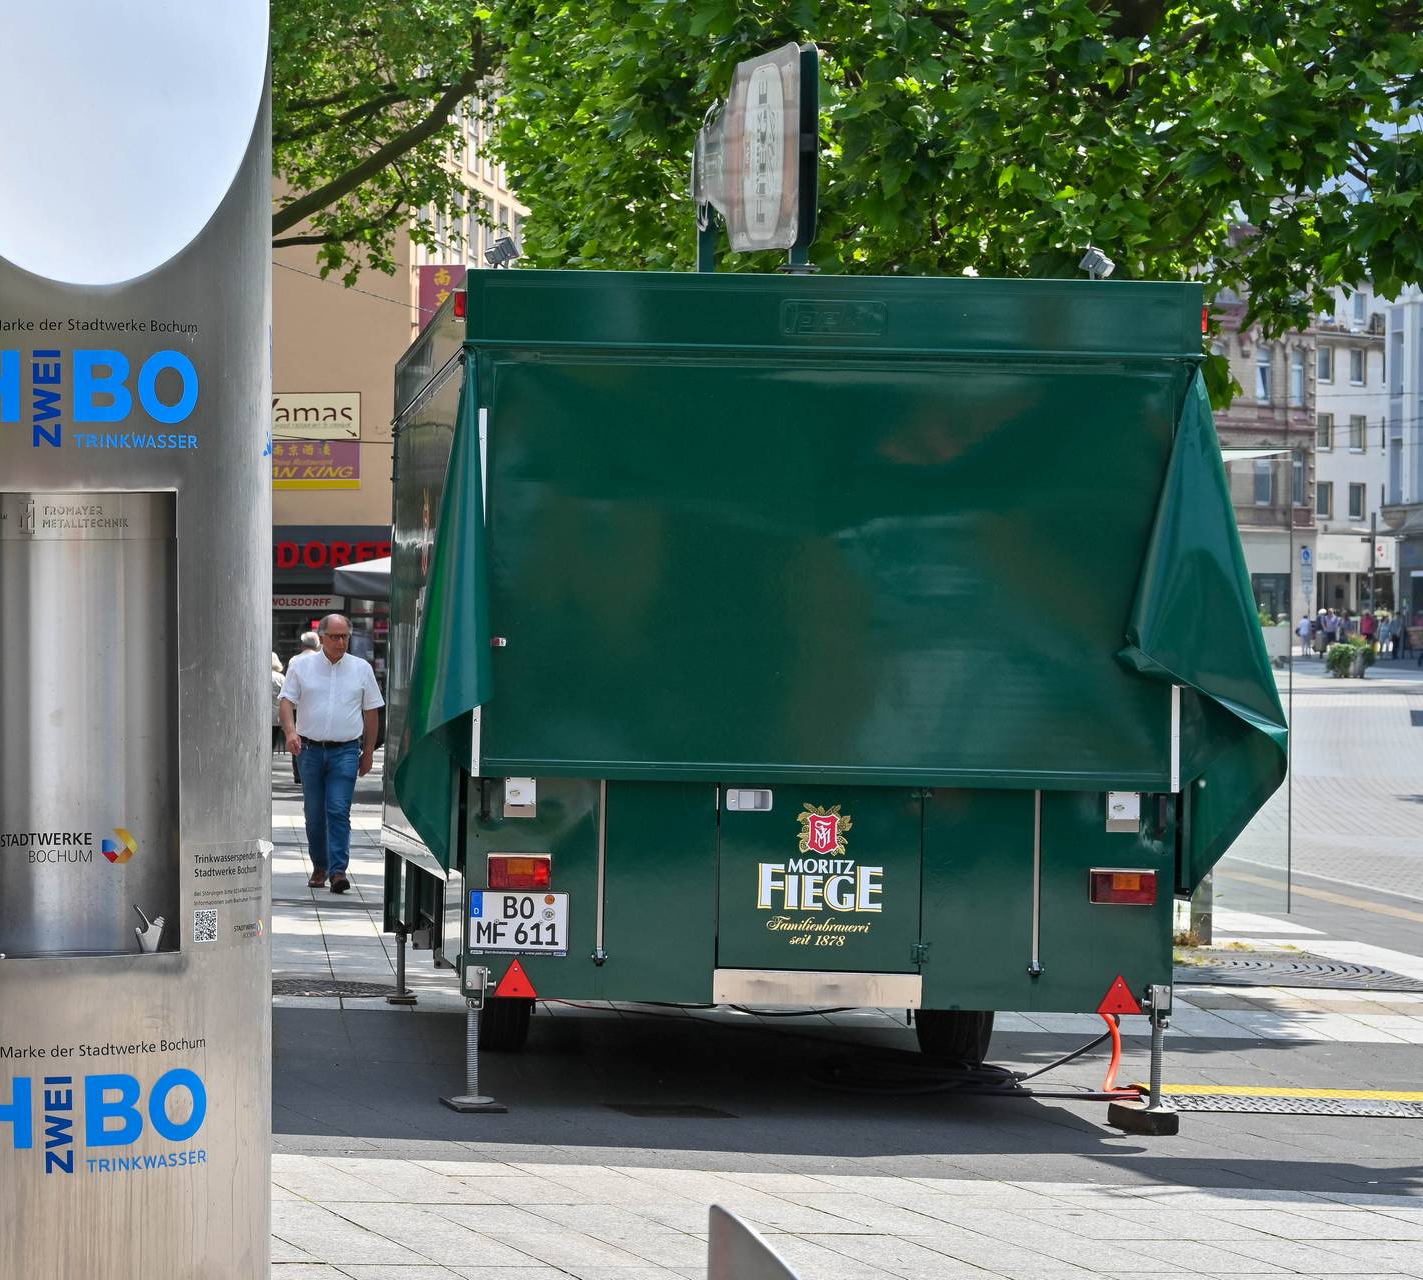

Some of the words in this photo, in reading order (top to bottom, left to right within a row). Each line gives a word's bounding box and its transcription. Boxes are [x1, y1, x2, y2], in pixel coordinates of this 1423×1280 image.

[39, 318, 63, 332] der
[68, 319, 146, 333] Stadtwerke
[150, 319, 199, 334] Bochum
[32, 349, 62, 448] ZWEI
[272, 398, 352, 422] amas
[73, 433, 199, 449] TRINKWASSER
[302, 466, 354, 478] KING
[42, 505, 104, 516] TROMAYER
[41, 518, 130, 529] METALLTECHNIK
[0, 832, 93, 848] STADTWERKE
[28, 849, 93, 864] BOCHUM
[194, 851, 257, 863] Trinkwasserspender
[194, 866, 236, 878] Stadtwerke
[787, 858, 855, 875] MORITZ
[757, 862, 884, 913] FIEGE
[473, 907, 480, 915] D
[503, 895, 535, 920] BO
[766, 915, 872, 934] Familienbrauerei
[476, 921, 508, 945] MF
[514, 922, 560, 946] 611
[789, 934, 812, 946] seit
[814, 934, 846, 947] 1878
[0, 1045, 46, 1059] Marke
[50, 1045, 74, 1058] der
[78, 1041, 156, 1057] Stadtwerke
[159, 1037, 206, 1052] Bochum
[43, 1075, 74, 1174] ZWEI
[86, 1150, 207, 1173] TRINKWASSER
